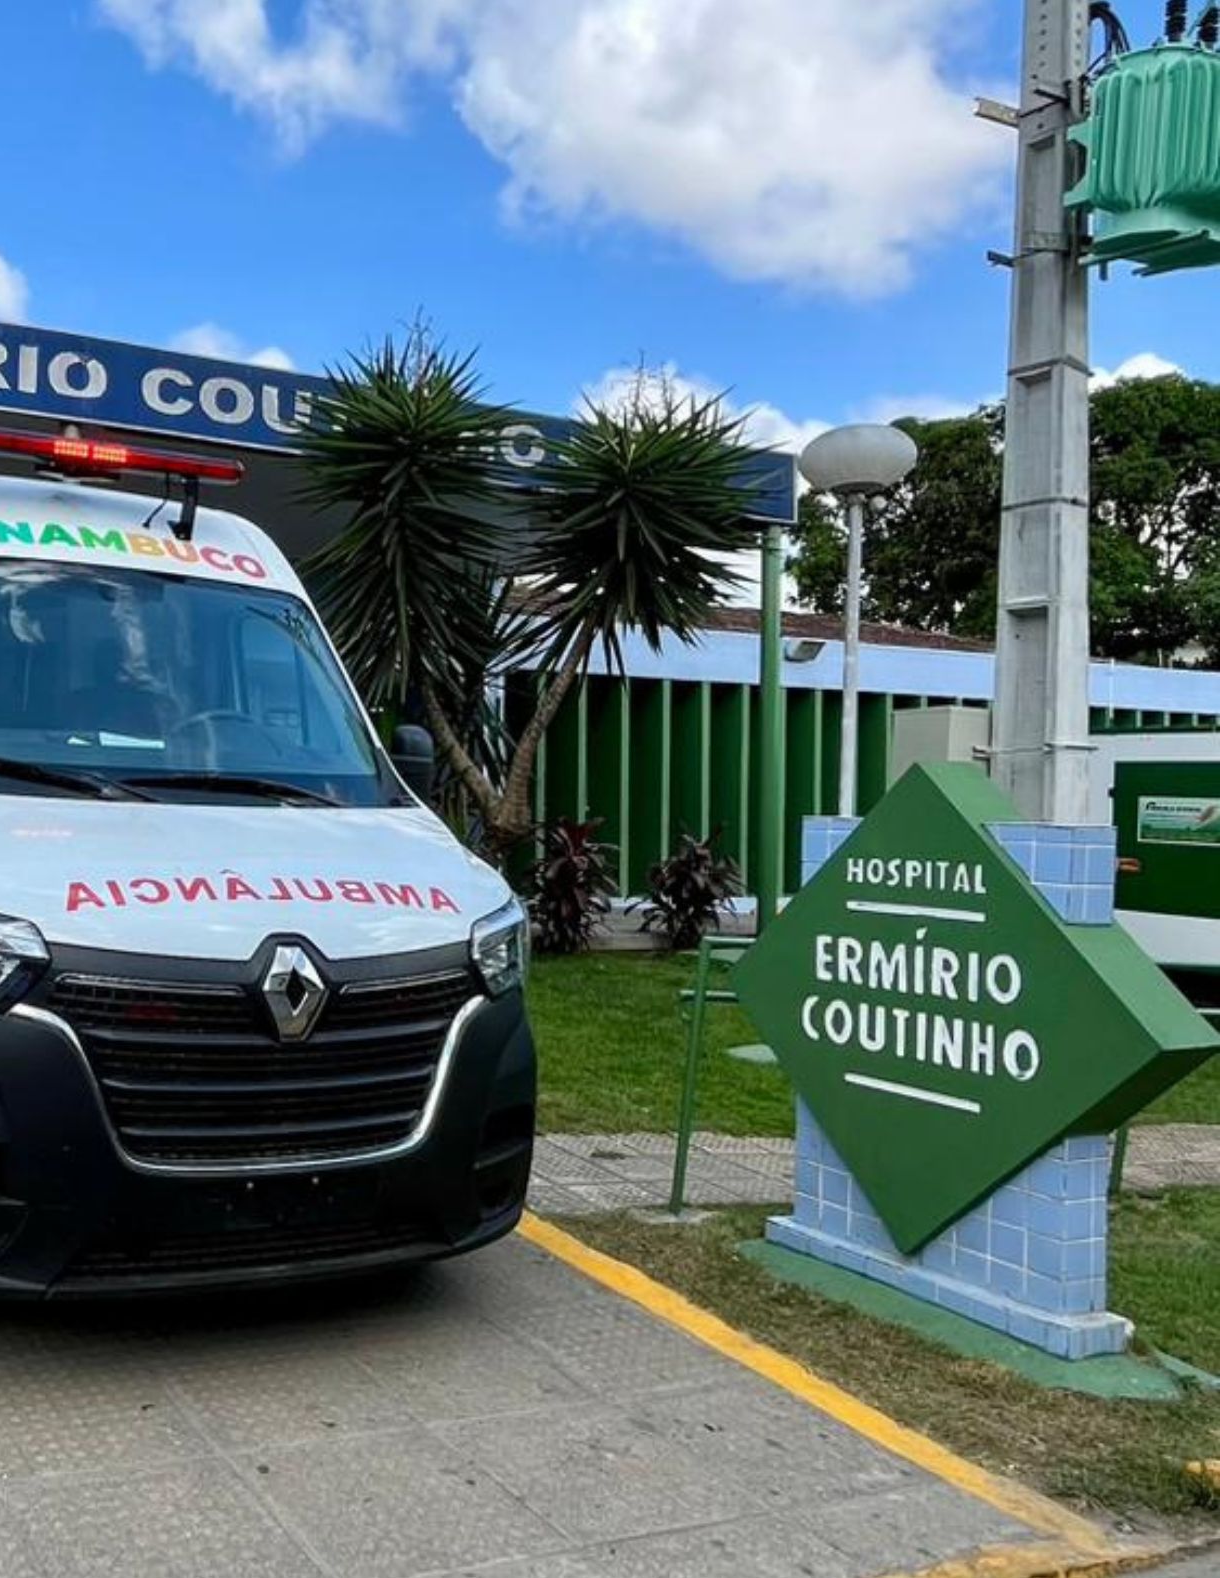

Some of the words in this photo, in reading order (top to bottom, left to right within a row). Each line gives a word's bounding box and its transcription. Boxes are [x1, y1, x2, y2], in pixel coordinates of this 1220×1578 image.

[846, 857, 987, 895] HOSPITAL
[815, 926, 1022, 1004] ERMÍRIO
[801, 996, 1040, 1082] COUTINHO
